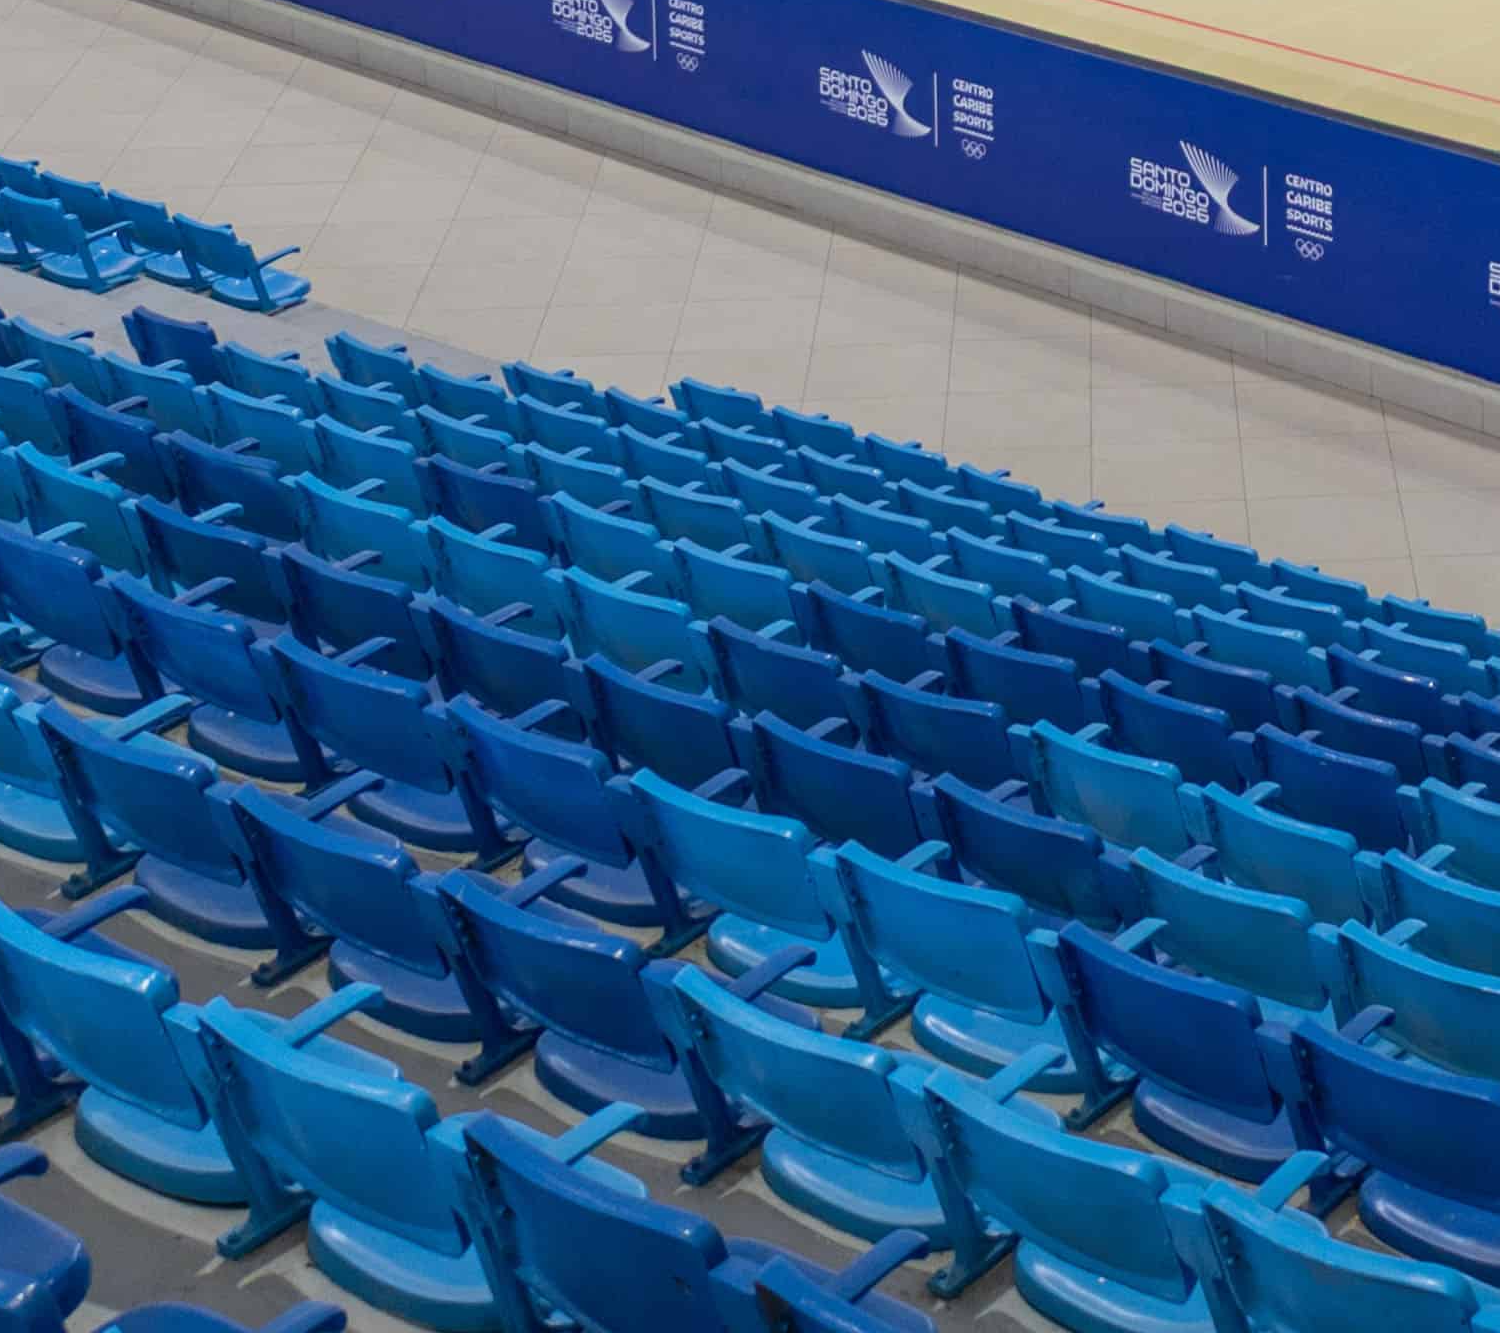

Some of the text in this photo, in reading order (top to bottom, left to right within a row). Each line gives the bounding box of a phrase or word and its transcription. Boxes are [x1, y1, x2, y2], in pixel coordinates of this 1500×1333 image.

[552, 2, 613, 30] DOMINGO
[668, 11, 704, 32] CARIBE
[576, 22, 613, 44] 2026
[669, 26, 705, 46] SPORTS
[819, 66, 872, 94] SANTO
[953, 78, 994, 100] CENTRO
[819, 80, 888, 113] DOMINGO
[953, 94, 993, 116] CARIBE
[847, 103, 888, 128] 2026
[953, 110, 994, 132] SPORTS
[1130, 156, 1191, 189] SANTO
[1130, 172, 1210, 208] DOMINGO
[1285, 173, 1333, 197] CENTRO
[1161, 198, 1210, 225] 2026
[1285, 190, 1333, 216] CARIBE
[1285, 208, 1333, 232] SPORTS
